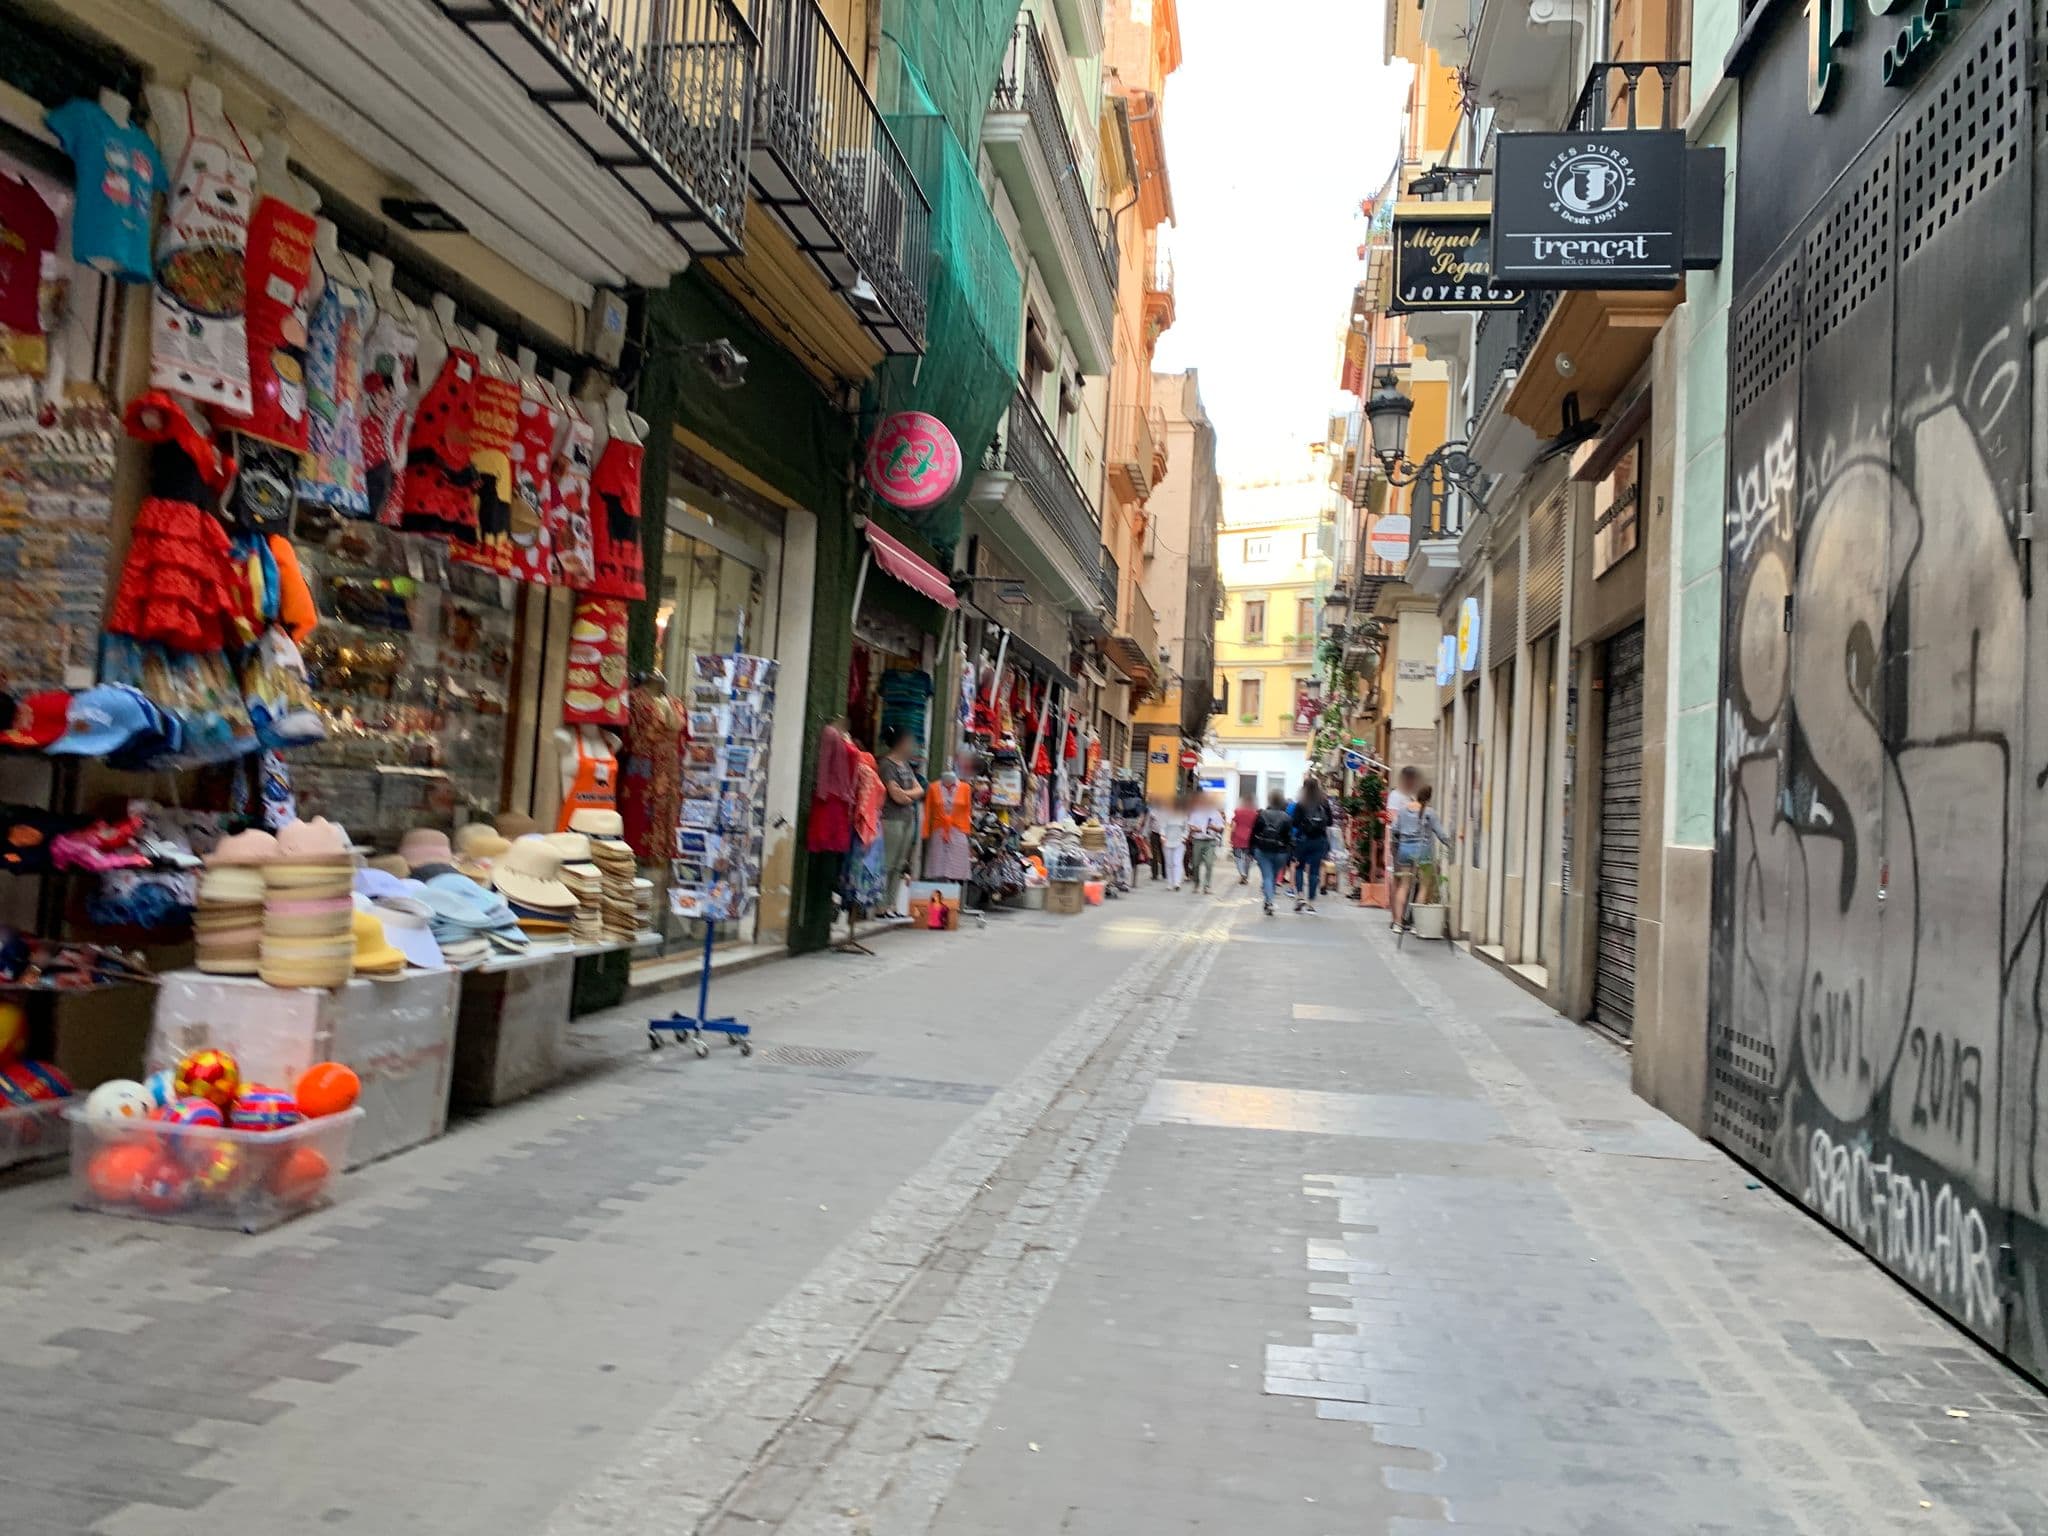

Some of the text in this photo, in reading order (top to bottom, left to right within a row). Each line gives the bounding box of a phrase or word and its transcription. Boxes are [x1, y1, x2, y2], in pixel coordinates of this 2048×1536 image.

[1544, 144, 1636, 189] CAFES DURBAN
[1560, 210, 1617, 225] Desde 1957
[1403, 227, 1481, 256] Miguel
[1532, 236, 1649, 260] trencat
[1561, 258, 1585, 266] DOLÇ
